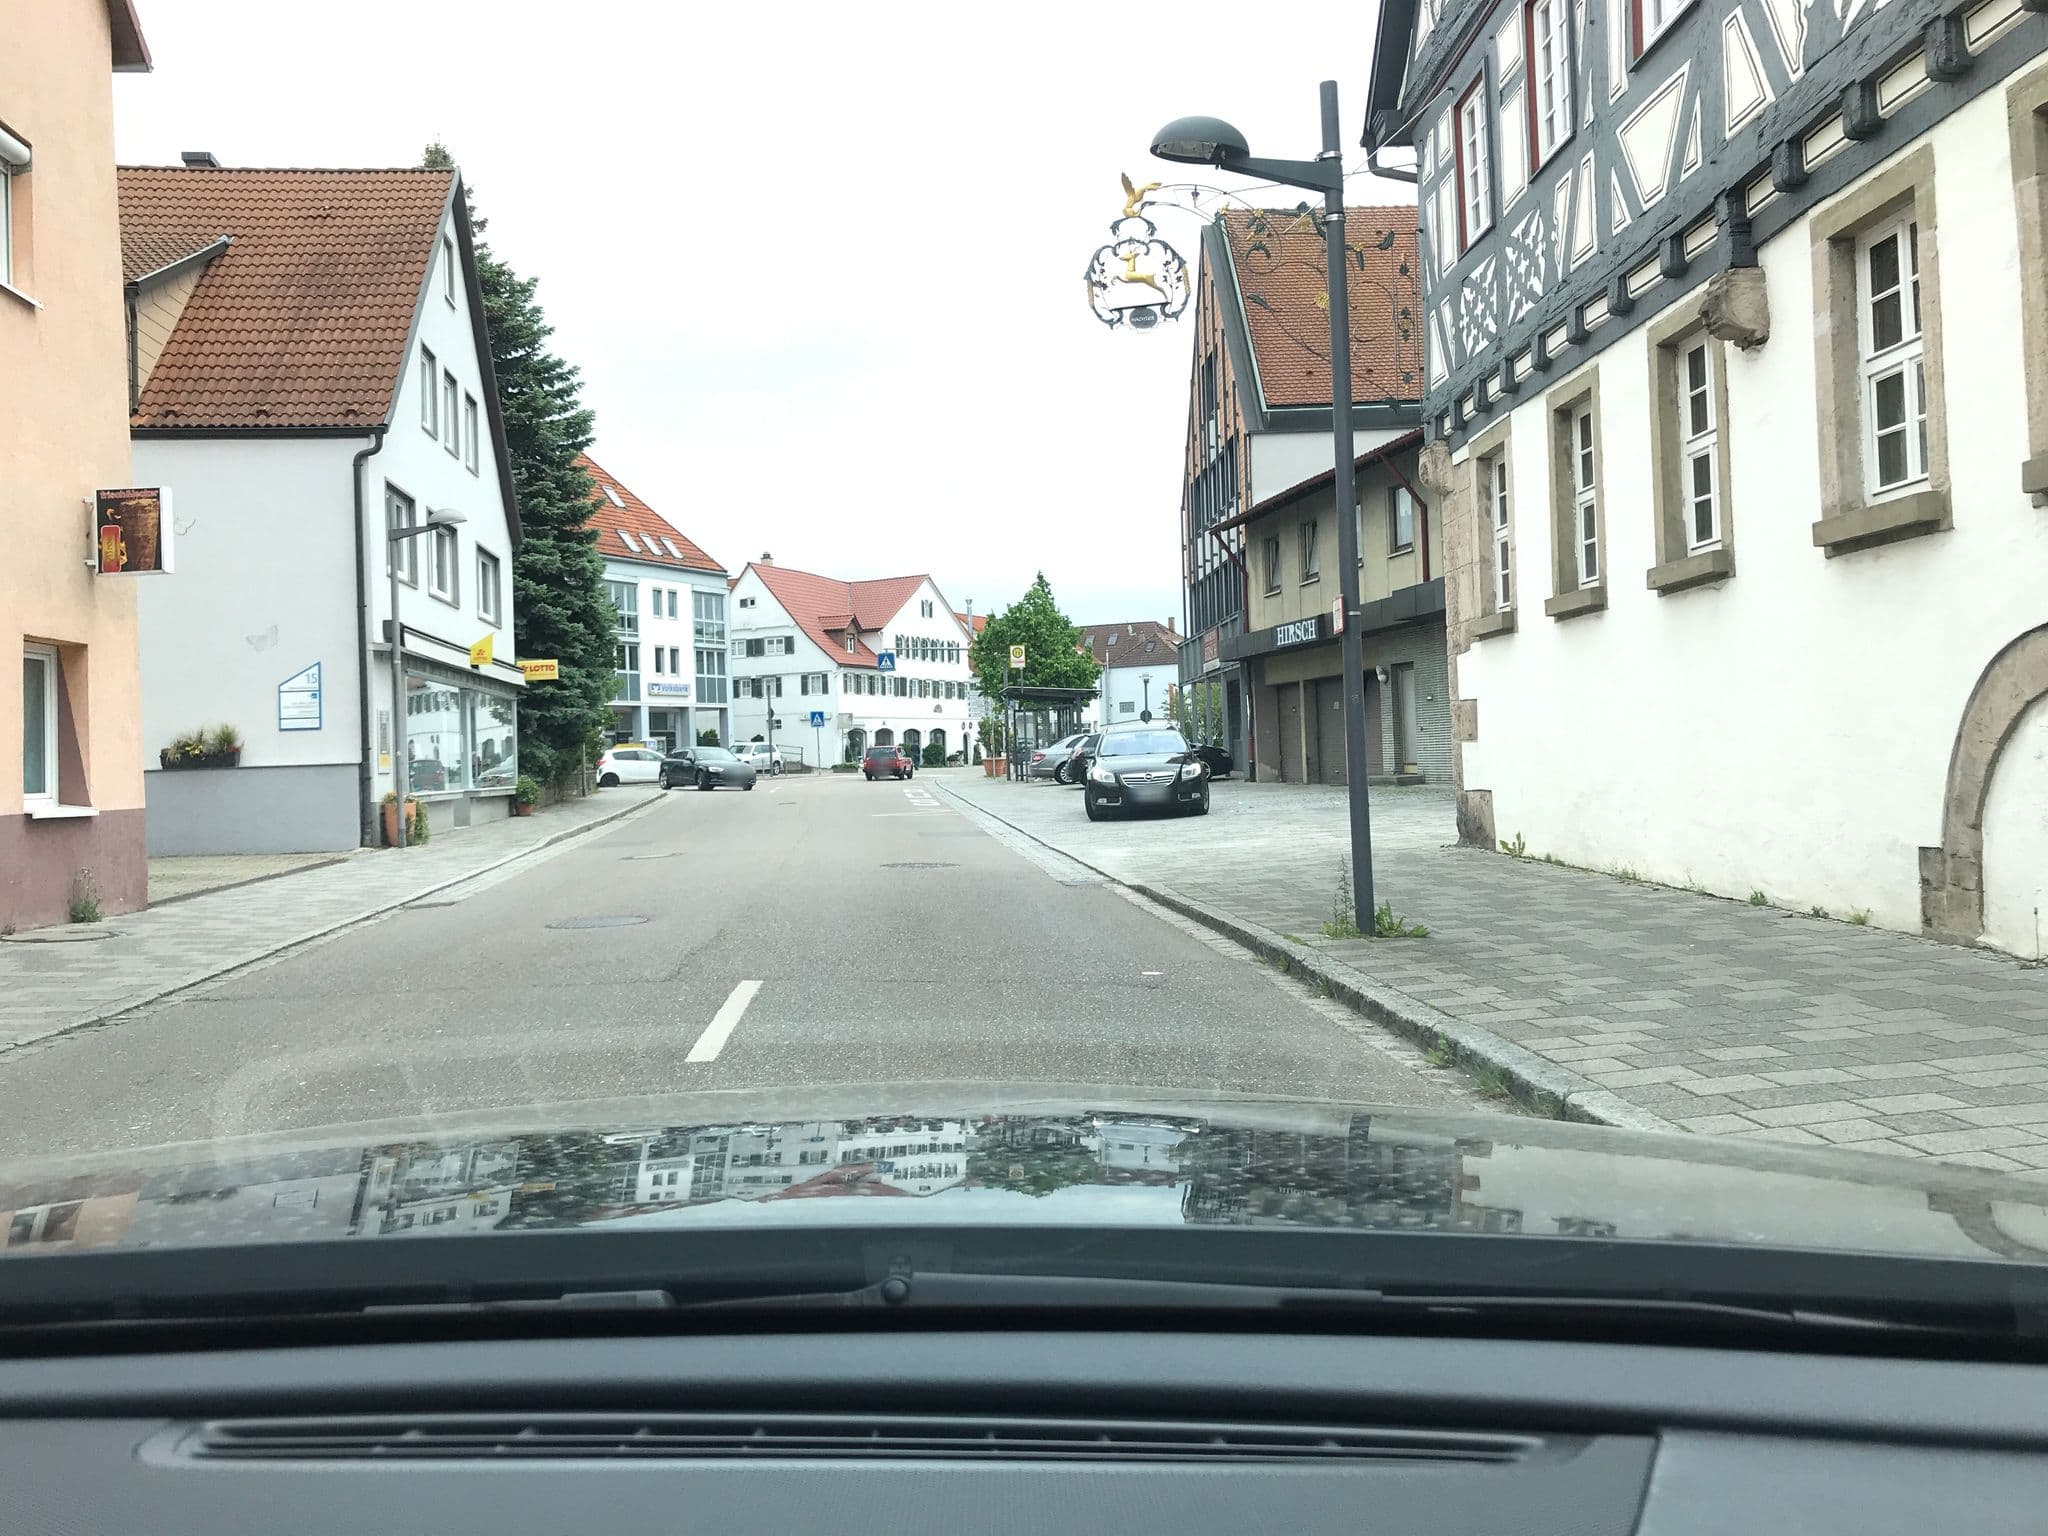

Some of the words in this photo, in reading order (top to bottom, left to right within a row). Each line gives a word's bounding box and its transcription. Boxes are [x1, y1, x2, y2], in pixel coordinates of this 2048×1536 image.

[1276, 619, 1316, 646] HIRSCH
[529, 664, 556, 673] LOTTO
[305, 673, 318, 684] 15
